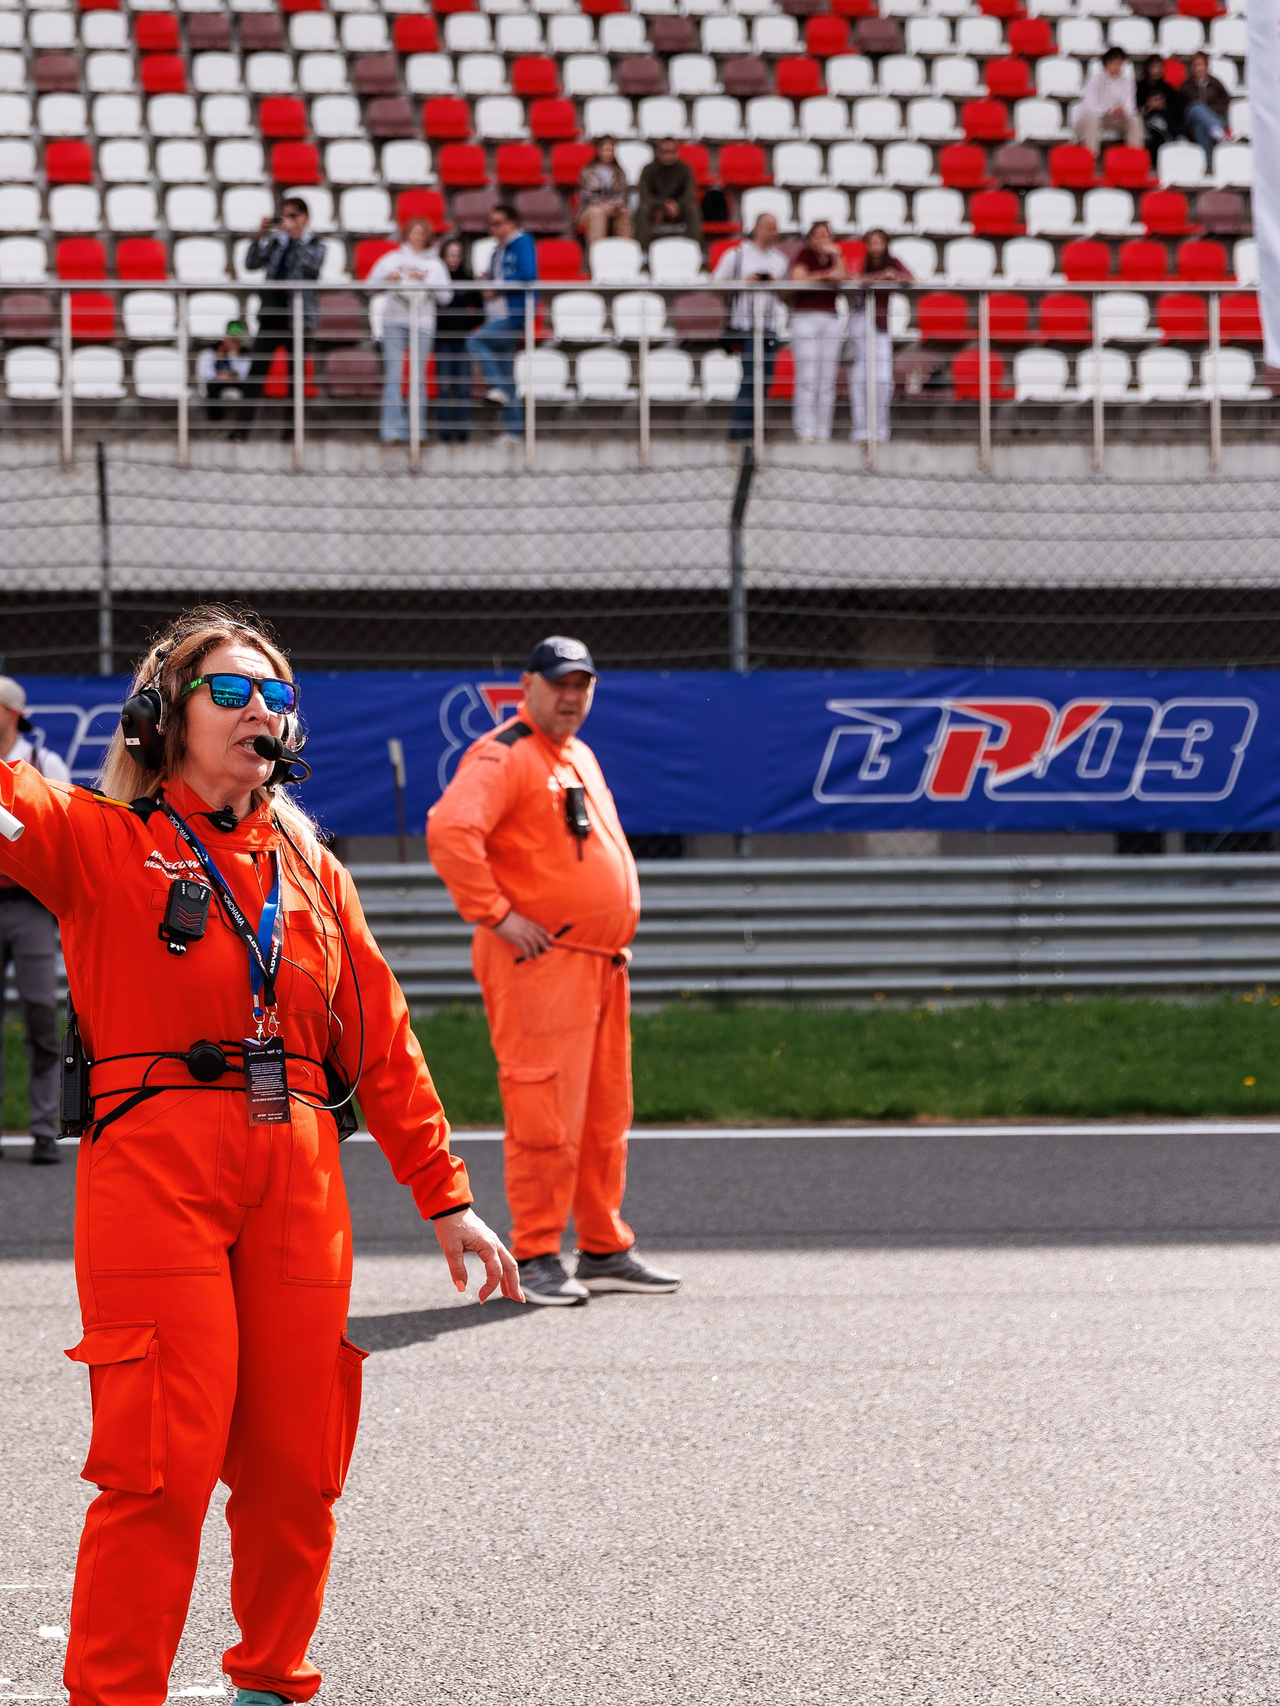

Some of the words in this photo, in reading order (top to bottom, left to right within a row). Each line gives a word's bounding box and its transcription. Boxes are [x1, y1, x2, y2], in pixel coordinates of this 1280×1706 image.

[168, 814, 190, 841] YOKOAMA
[223, 893, 245, 927] YOKOHAMA
[268, 938, 280, 974] ADVAN
